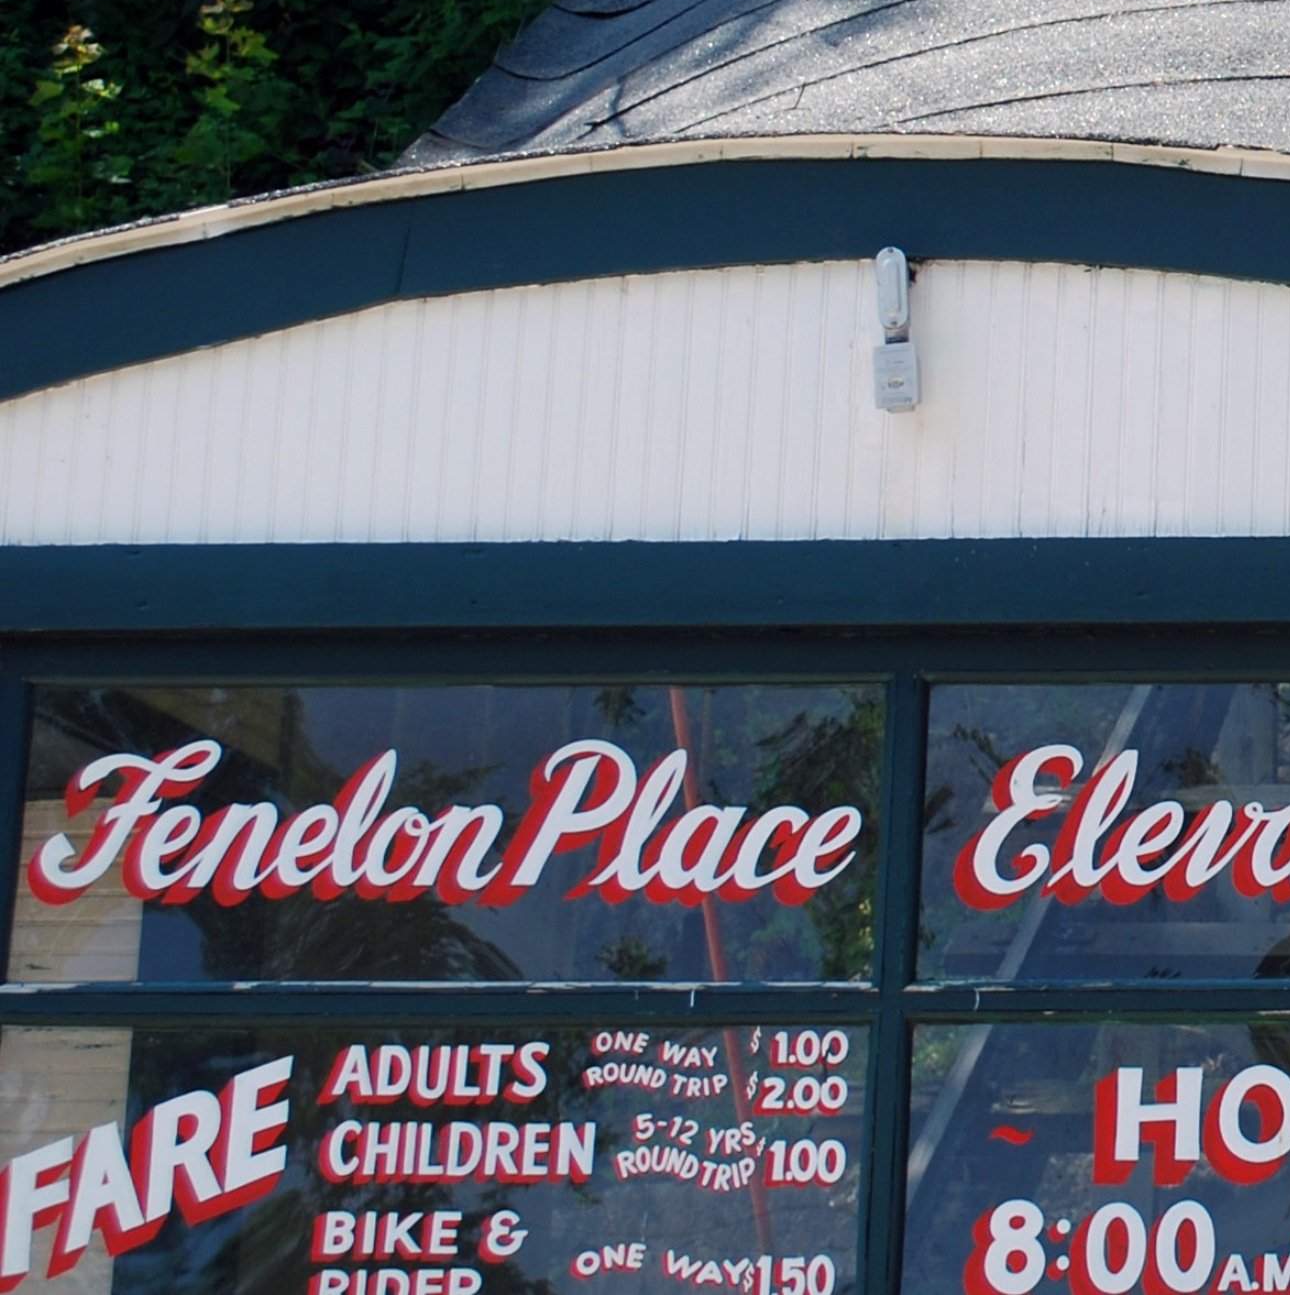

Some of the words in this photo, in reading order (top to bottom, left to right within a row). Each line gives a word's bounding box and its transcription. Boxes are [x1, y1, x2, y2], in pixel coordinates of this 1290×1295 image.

[40, 739, 508, 892] Fenelon
[510, 739, 862, 892] Place
[331, 1042, 549, 1098] ADULTS
[595, 1031, 649, 1053] ONE
[661, 1041, 717, 1067] WAY
[586, 1062, 666, 1086] ROUND
[671, 1074, 727, 1097] TRIP
[747, 1071, 848, 1110] $2.00
[328, 1120, 595, 1176] CHILDREN
[634, 1113, 699, 1145] 5-12
[707, 1122, 755, 1154] YRS
[2, 1055, 293, 1277] FARE
[616, 1146, 698, 1179] ROUND
[700, 1157, 755, 1191] TRIP
[317, 1211, 462, 1256] BIKE
[485, 1211, 528, 1256] &
[984, 1199, 1216, 1295] 8:00
[314, 1267, 483, 1295] RIDER
[575, 1244, 647, 1276] ONE
[664, 1250, 752, 1285] WAY
